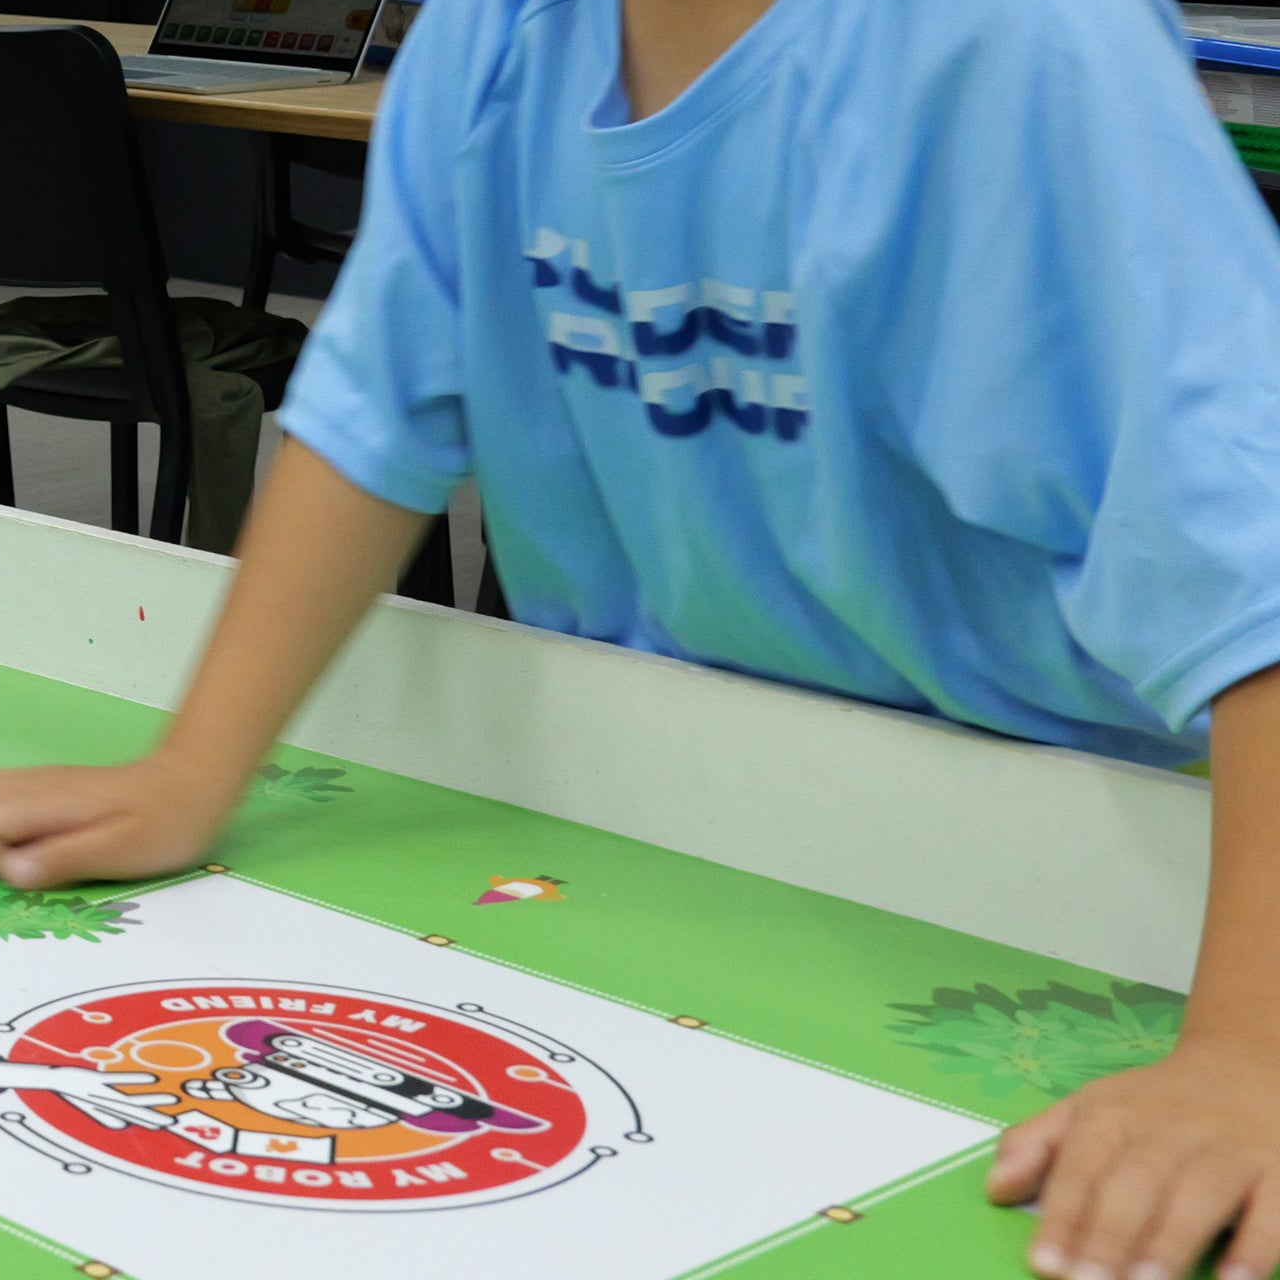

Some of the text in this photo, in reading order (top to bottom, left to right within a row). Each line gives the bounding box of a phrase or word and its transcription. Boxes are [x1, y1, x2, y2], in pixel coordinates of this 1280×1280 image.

[160, 994, 427, 1033] MY FRIEND
[174, 1151, 468, 1188] MY ROBOT
